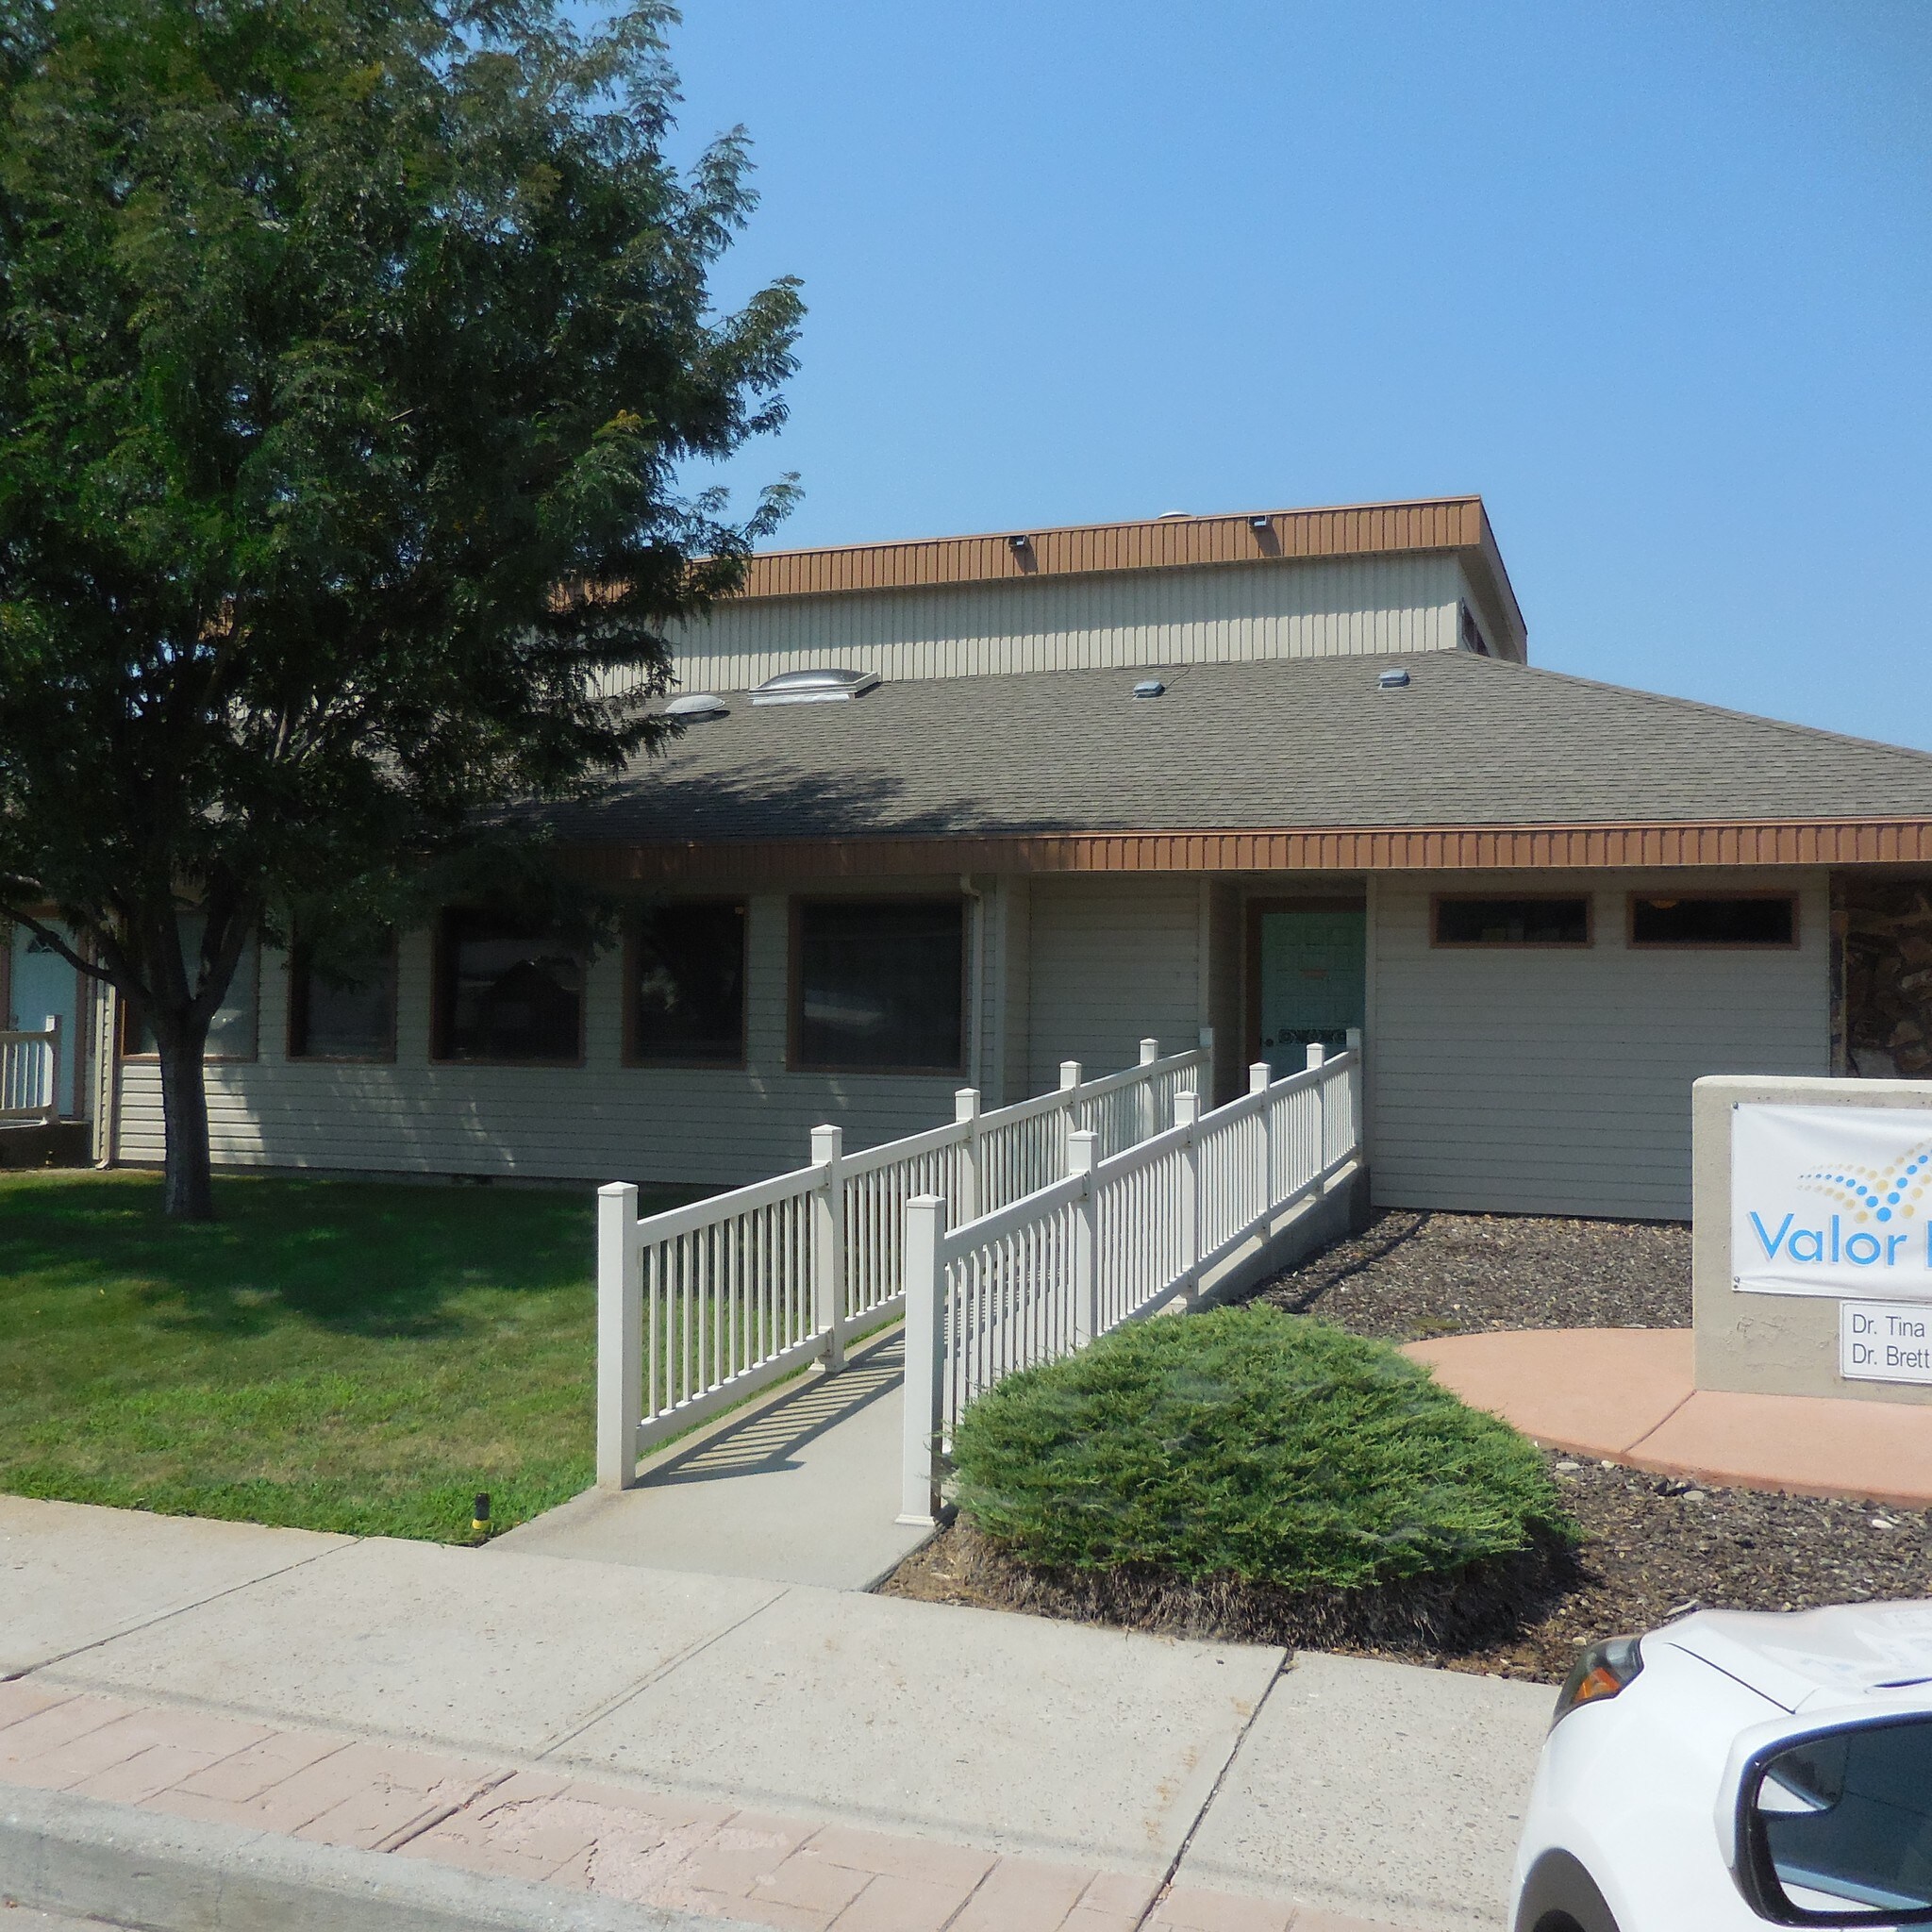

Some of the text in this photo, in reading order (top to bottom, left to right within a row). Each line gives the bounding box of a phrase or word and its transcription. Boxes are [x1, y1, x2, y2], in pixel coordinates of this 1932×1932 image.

[1749, 1211, 1907, 1266] Valor
[1853, 1313, 1925, 1338] Dr. Tina
[1853, 1343, 1930, 1369] Dr. Brett
